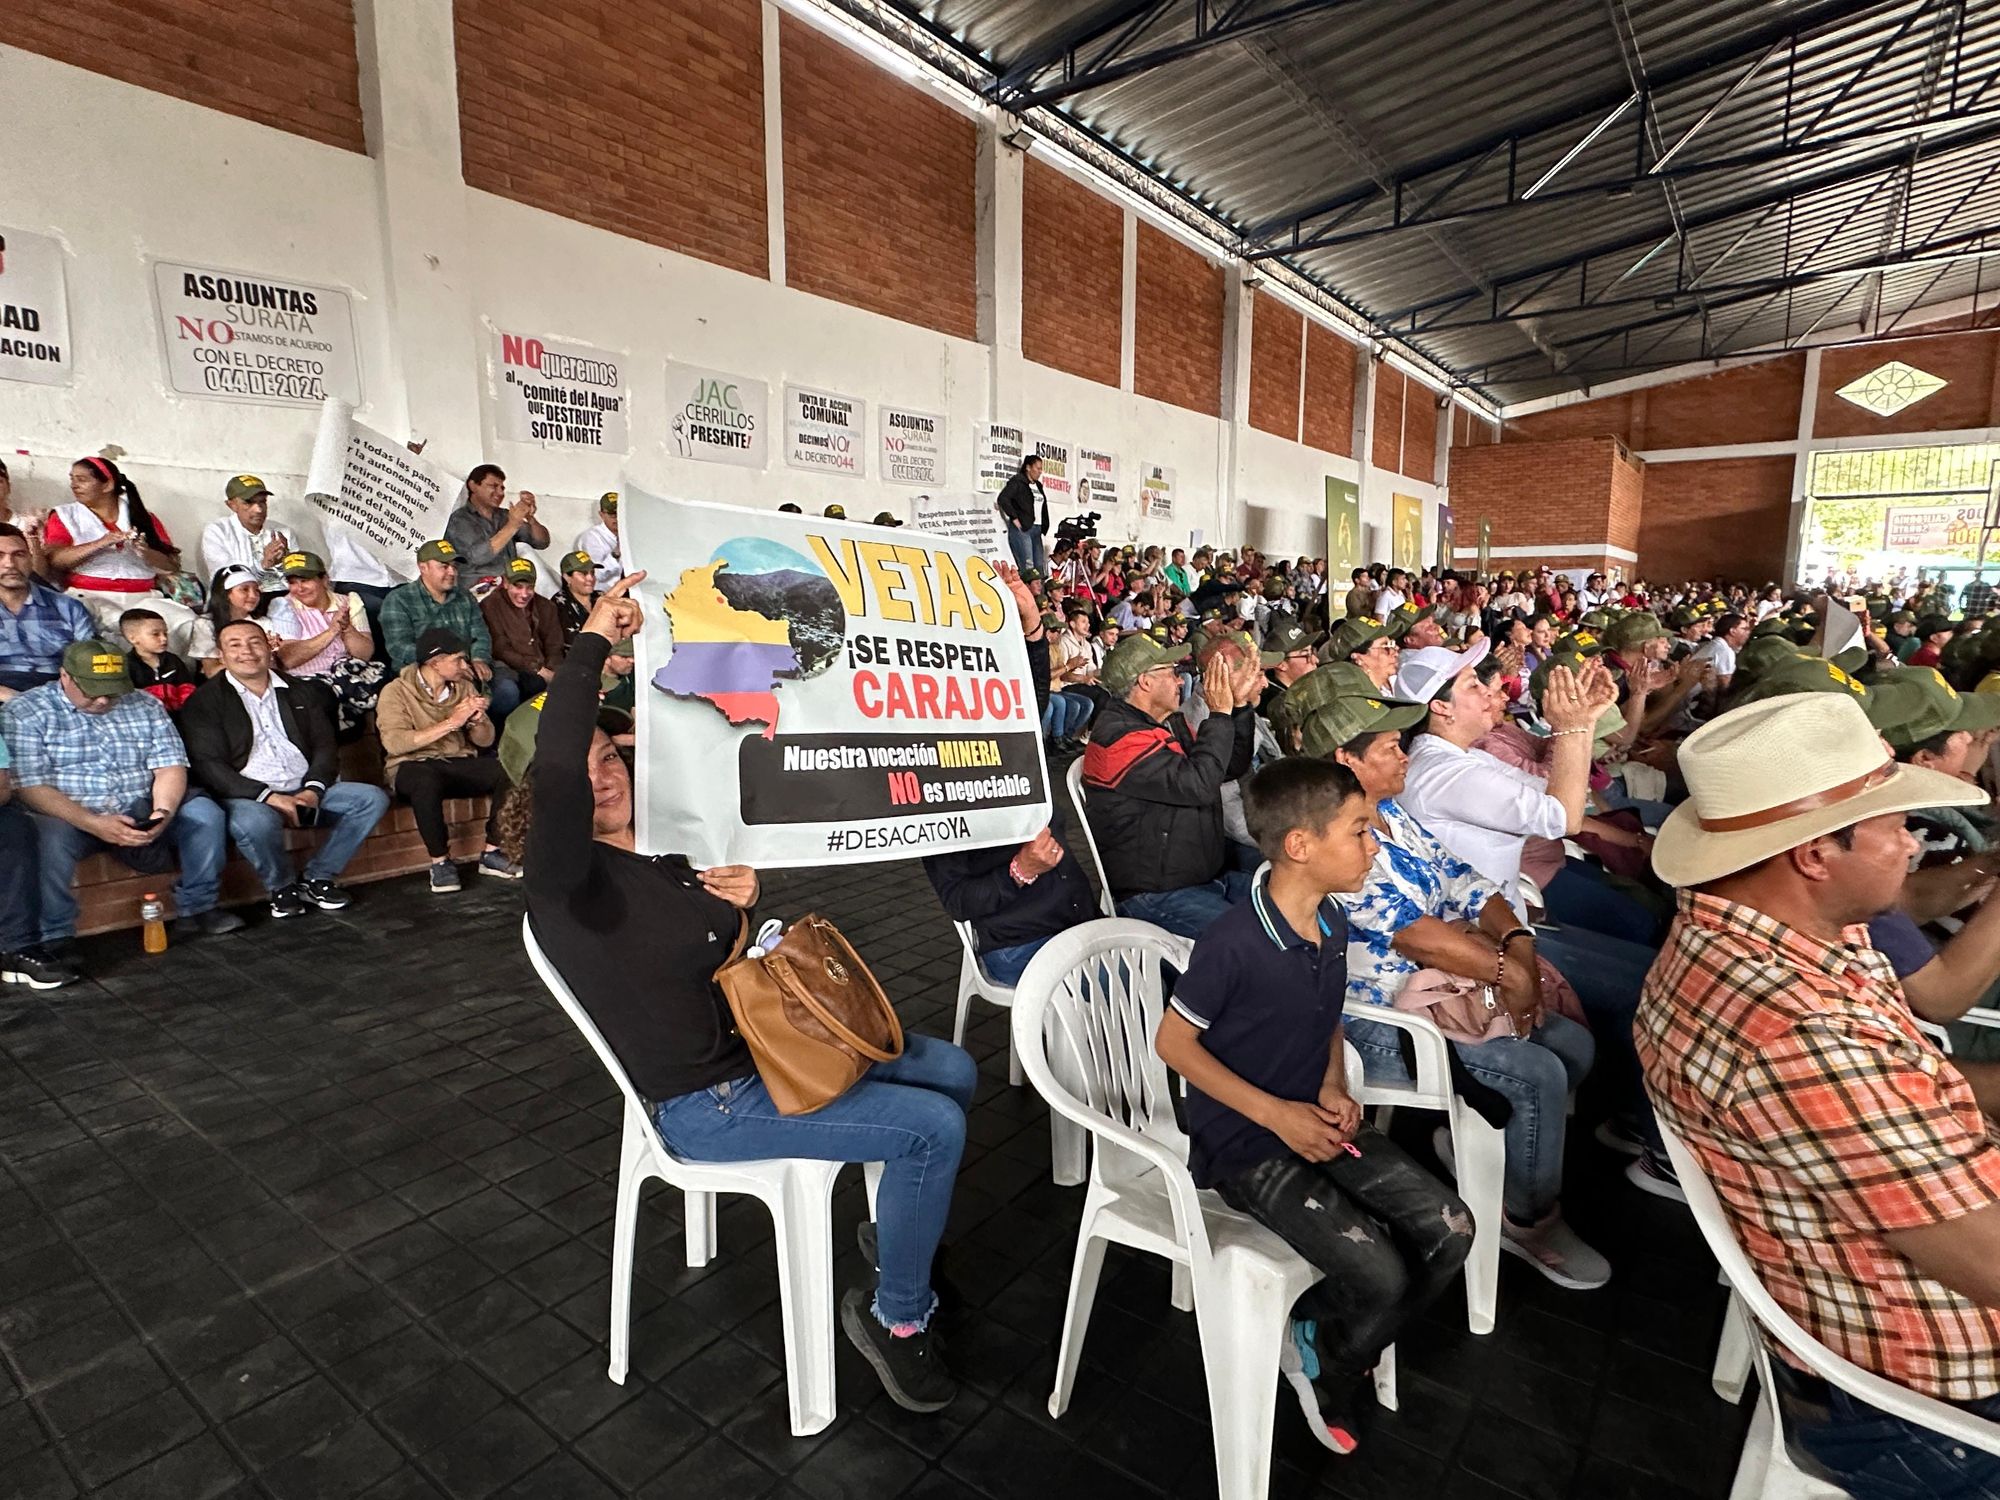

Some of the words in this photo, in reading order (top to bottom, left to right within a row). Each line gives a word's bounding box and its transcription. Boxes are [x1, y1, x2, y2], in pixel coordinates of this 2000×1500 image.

[183, 272, 318, 316] ASOJUNTAS
[0, 303, 40, 332] AD
[225, 303, 314, 334] SURATA
[175, 315, 236, 345] NO
[275, 336, 288, 347] DE
[290, 340, 333, 353] ACUERDO
[193, 347, 230, 366] CON
[234, 352, 251, 369] EL
[256, 354, 324, 376] DECRETO
[502, 333, 544, 370] NO
[539, 350, 618, 388] queremos
[204, 365, 247, 394] 044
[249, 370, 274, 396] DE
[274, 373, 329, 401] 2024
[505, 370, 516, 384] al
[569, 388, 589, 408] del
[694, 377, 738, 411] JAC
[527, 400, 545, 416] QUE
[545, 403, 604, 429] DESTRUYE
[685, 403, 755, 431] CERRILLOS
[798, 392, 818, 406] JUNTA
[819, 398, 827, 408] DE
[829, 399, 852, 414] ACCION
[802, 404, 849, 427] COMUNAL
[531, 420, 564, 442] SOTO
[566, 426, 602, 446] NORTE
[690, 424, 753, 449] PRESENTE!
[889, 412, 934, 433] ASOJUNTAS
[902, 429, 932, 444] SURATA
[798, 433, 828, 449] DECIMOS
[885, 436, 905, 453] NO
[1035, 441, 1067, 464] ASOMAR
[353, 436, 361, 445] a
[364, 441, 394, 463] todas
[396, 457, 410, 473] las
[412, 468, 441, 493] partes
[794, 449, 803, 461] AL
[805, 451, 836, 466] DECRETO
[836, 455, 854, 470] 044
[889, 453, 902, 463] CON
[902, 456, 909, 465] EL
[910, 457, 935, 467] DECRETO
[347, 461, 383, 485] retirar
[384, 481, 430, 514] cualquier
[355, 448, 365, 461] la
[367, 458, 423, 494] autonomía
[424, 489, 436, 503] de
[312, 496, 365, 532] identidad
[365, 495, 383, 513] del
[384, 509, 409, 531] agua,
[409, 526, 427, 543] que
[376, 490, 416, 520] externa,
[341, 500, 406, 545] autogobierno
[407, 540, 414, 552] y
[804, 534, 1007, 635] VETAS
[847, 633, 891, 671] ¡SE
[898, 637, 1001, 673] RESPETA
[852, 669, 1027, 722] CARAJO!
[783, 744, 868, 772] Nuestra
[867, 742, 938, 769] vocación
[937, 740, 1003, 770] MINERA
[887, 771, 921, 806] NO
[922, 783, 944, 804] es
[945, 773, 1032, 804] negociable
